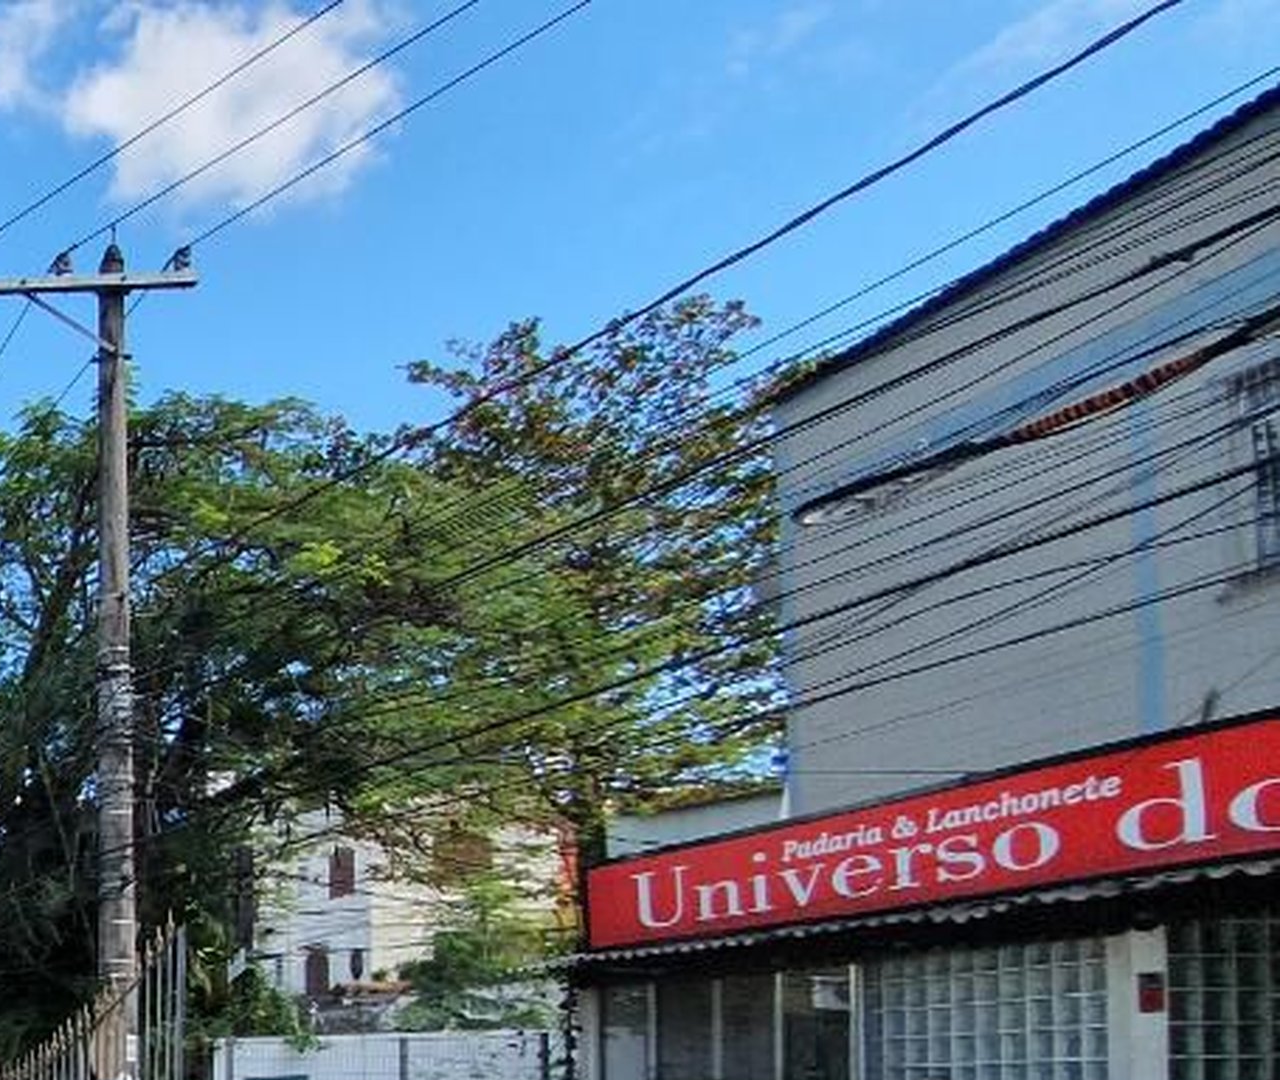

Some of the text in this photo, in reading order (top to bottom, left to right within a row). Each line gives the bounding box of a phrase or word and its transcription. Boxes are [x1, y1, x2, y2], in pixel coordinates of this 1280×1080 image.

[781, 775, 1122, 862] Padaria & Lanchonete
[630, 821, 1060, 928] Universo
